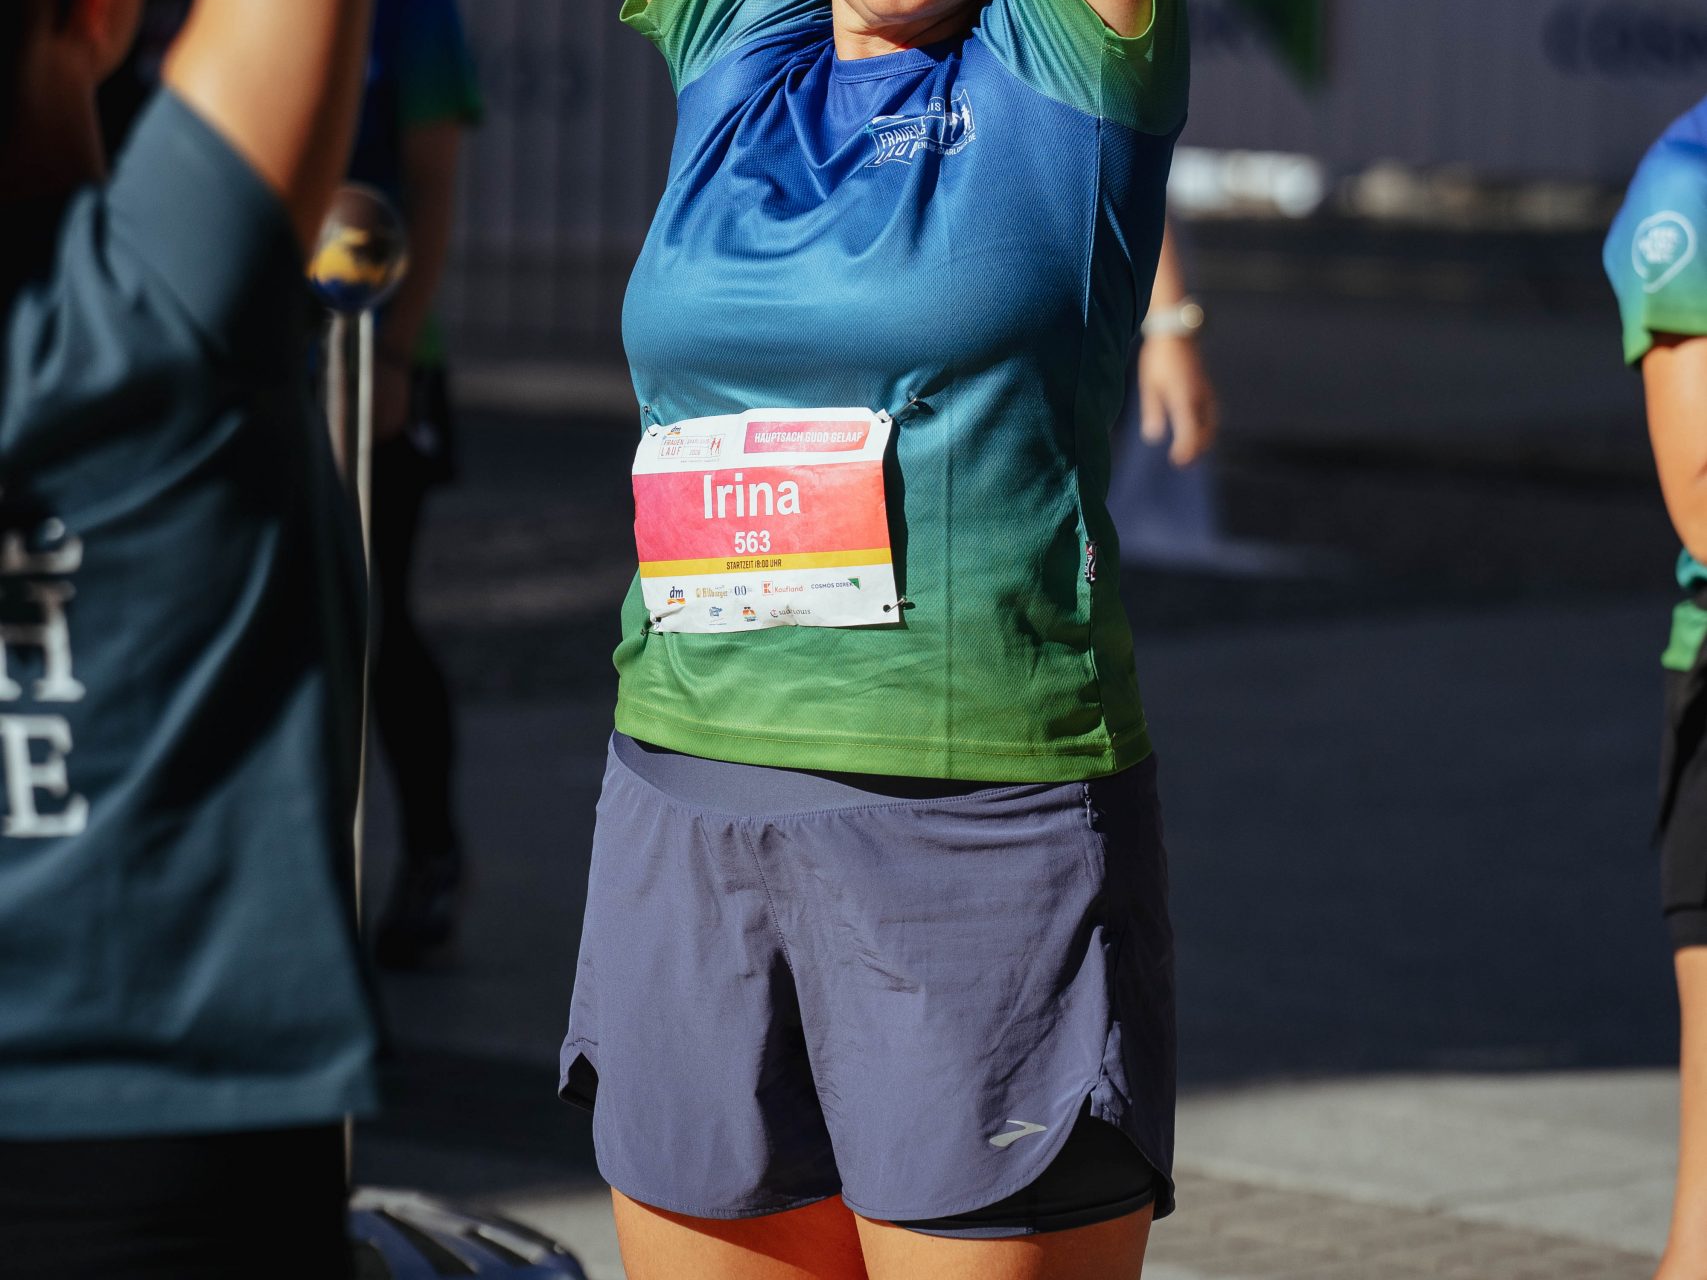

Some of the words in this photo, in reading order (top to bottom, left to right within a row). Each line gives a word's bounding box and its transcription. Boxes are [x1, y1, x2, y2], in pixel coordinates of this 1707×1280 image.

[879, 124, 920, 149] FRAUEN
[703, 472, 801, 519] Irina
[734, 530, 771, 554] 563
[726, 560, 754, 570] STARTZEIT
[754, 559, 769, 569] 18:00
[769, 558, 782, 568] UHR
[669, 585, 684, 598] dm
[810, 582, 835, 590] COSMOS
